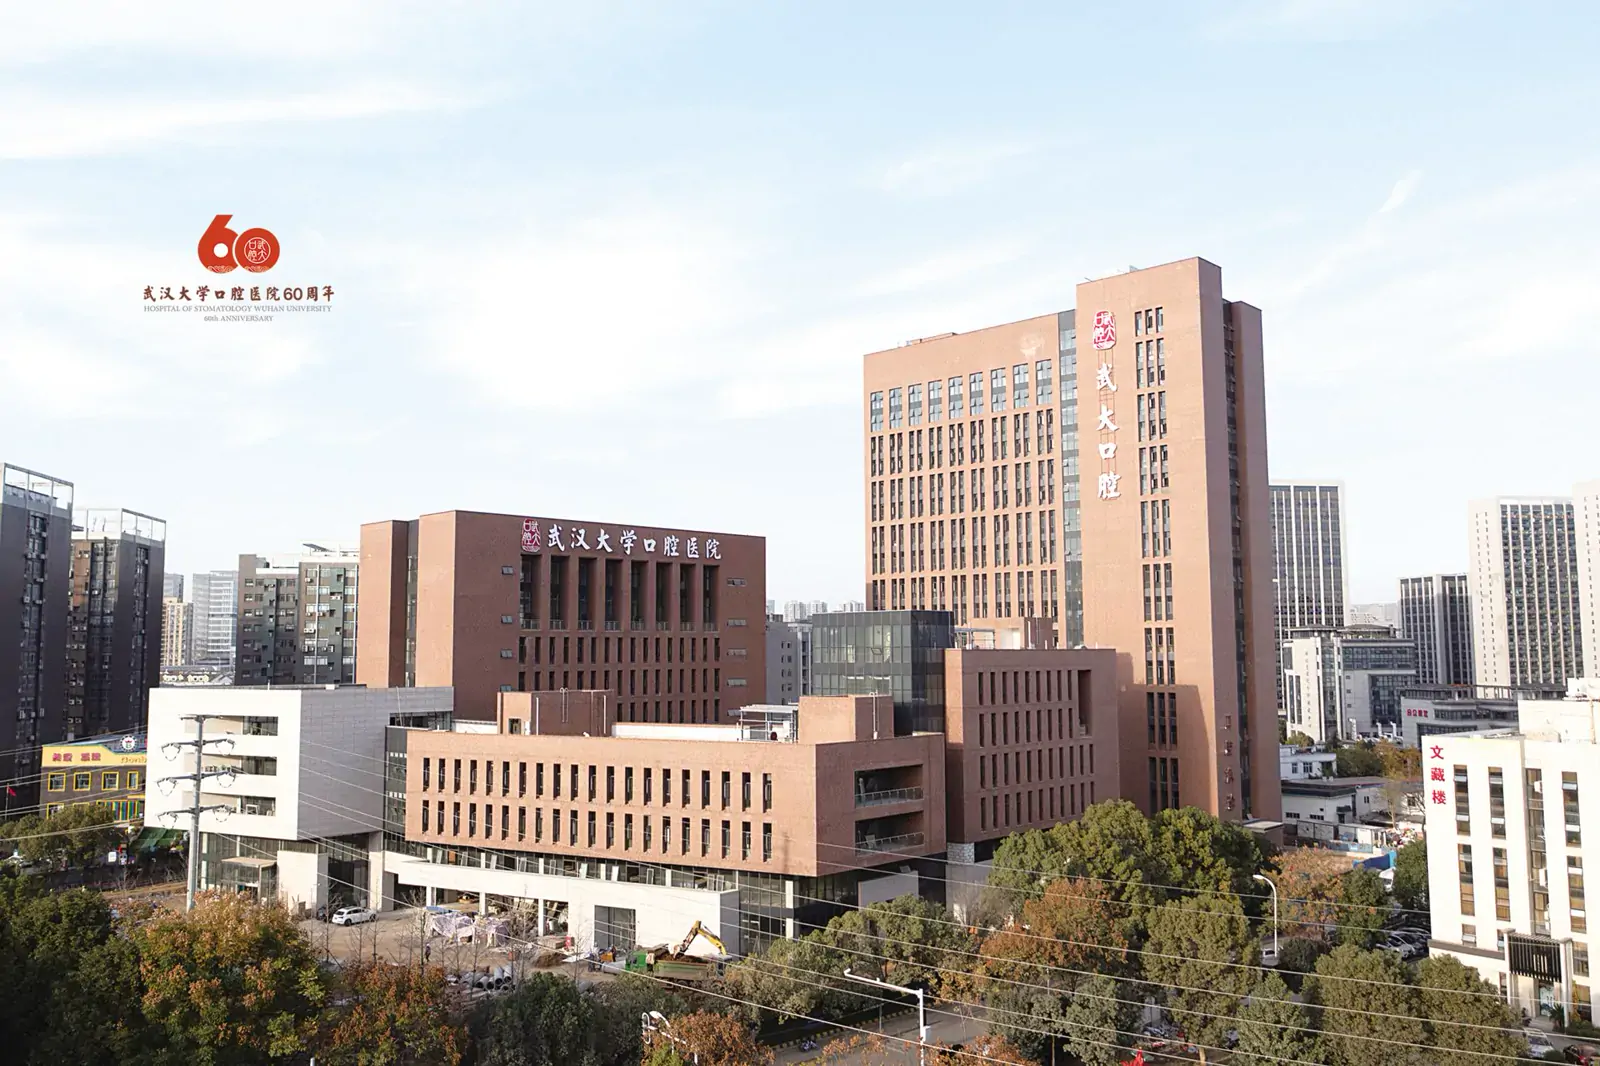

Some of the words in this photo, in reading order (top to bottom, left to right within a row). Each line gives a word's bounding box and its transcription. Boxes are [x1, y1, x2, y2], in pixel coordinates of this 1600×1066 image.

[1096, 363, 1121, 499] 武大口腔
[547, 524, 722, 560] 武汉大学口腔医院
[1429, 745, 1446, 805] 文藏楼
